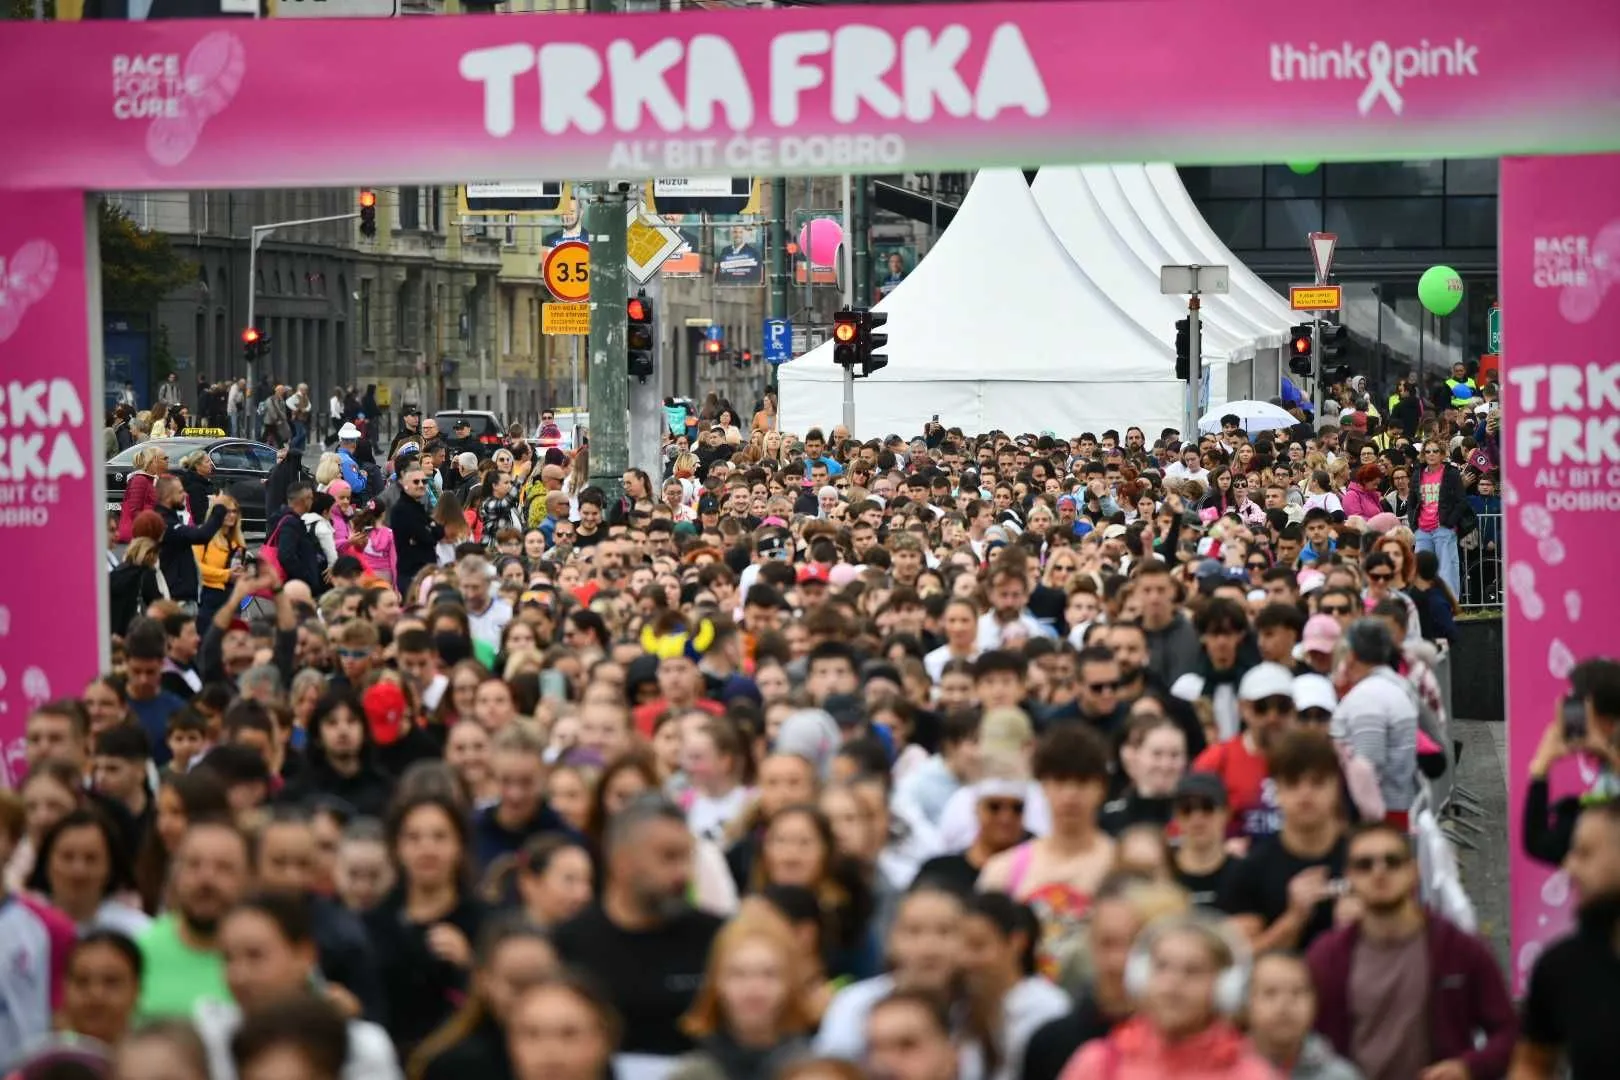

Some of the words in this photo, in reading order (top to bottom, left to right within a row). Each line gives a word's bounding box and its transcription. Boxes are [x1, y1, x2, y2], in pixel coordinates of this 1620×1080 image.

[112, 53, 180, 77] RACE
[1270, 41, 1367, 81] think
[1394, 38, 1479, 88] pink
[113, 77, 158, 97] FOR
[459, 33, 754, 138] TRKA
[769, 22, 1049, 127] FRKA
[113, 97, 179, 120] CURE
[663, 138, 717, 169] BIT
[779, 133, 905, 167] DOBRO
[1533, 236, 1588, 255] RACE
[556, 262, 589, 283] 3.5
[771, 324, 785, 341] P
[0, 377, 84, 428] KA
[0, 431, 87, 482] KA
[1568, 466, 1602, 489] BIT
[1545, 489, 1620, 513] DOBRO
